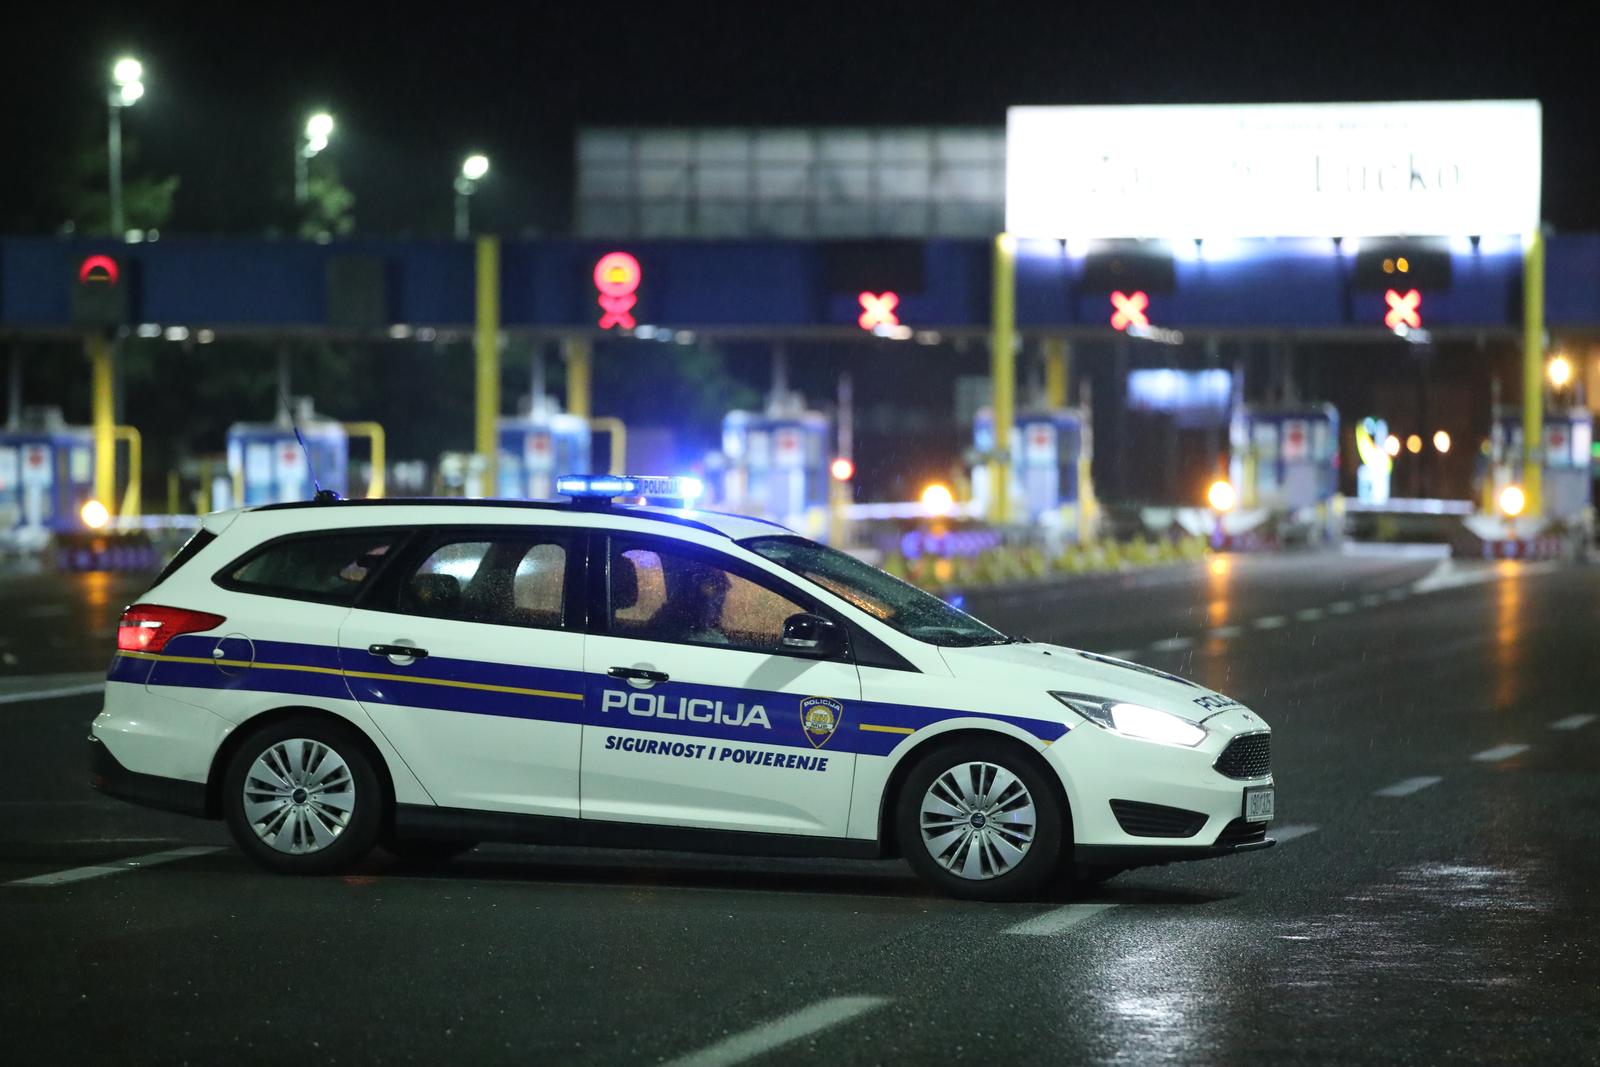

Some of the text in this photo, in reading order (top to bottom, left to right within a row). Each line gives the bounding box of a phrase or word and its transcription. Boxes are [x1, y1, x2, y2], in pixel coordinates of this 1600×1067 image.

[601, 689, 771, 729] POLICIJA
[803, 699, 840, 711] POLICIJA
[605, 735, 829, 772] SIGURNOST I POVJERENJE
